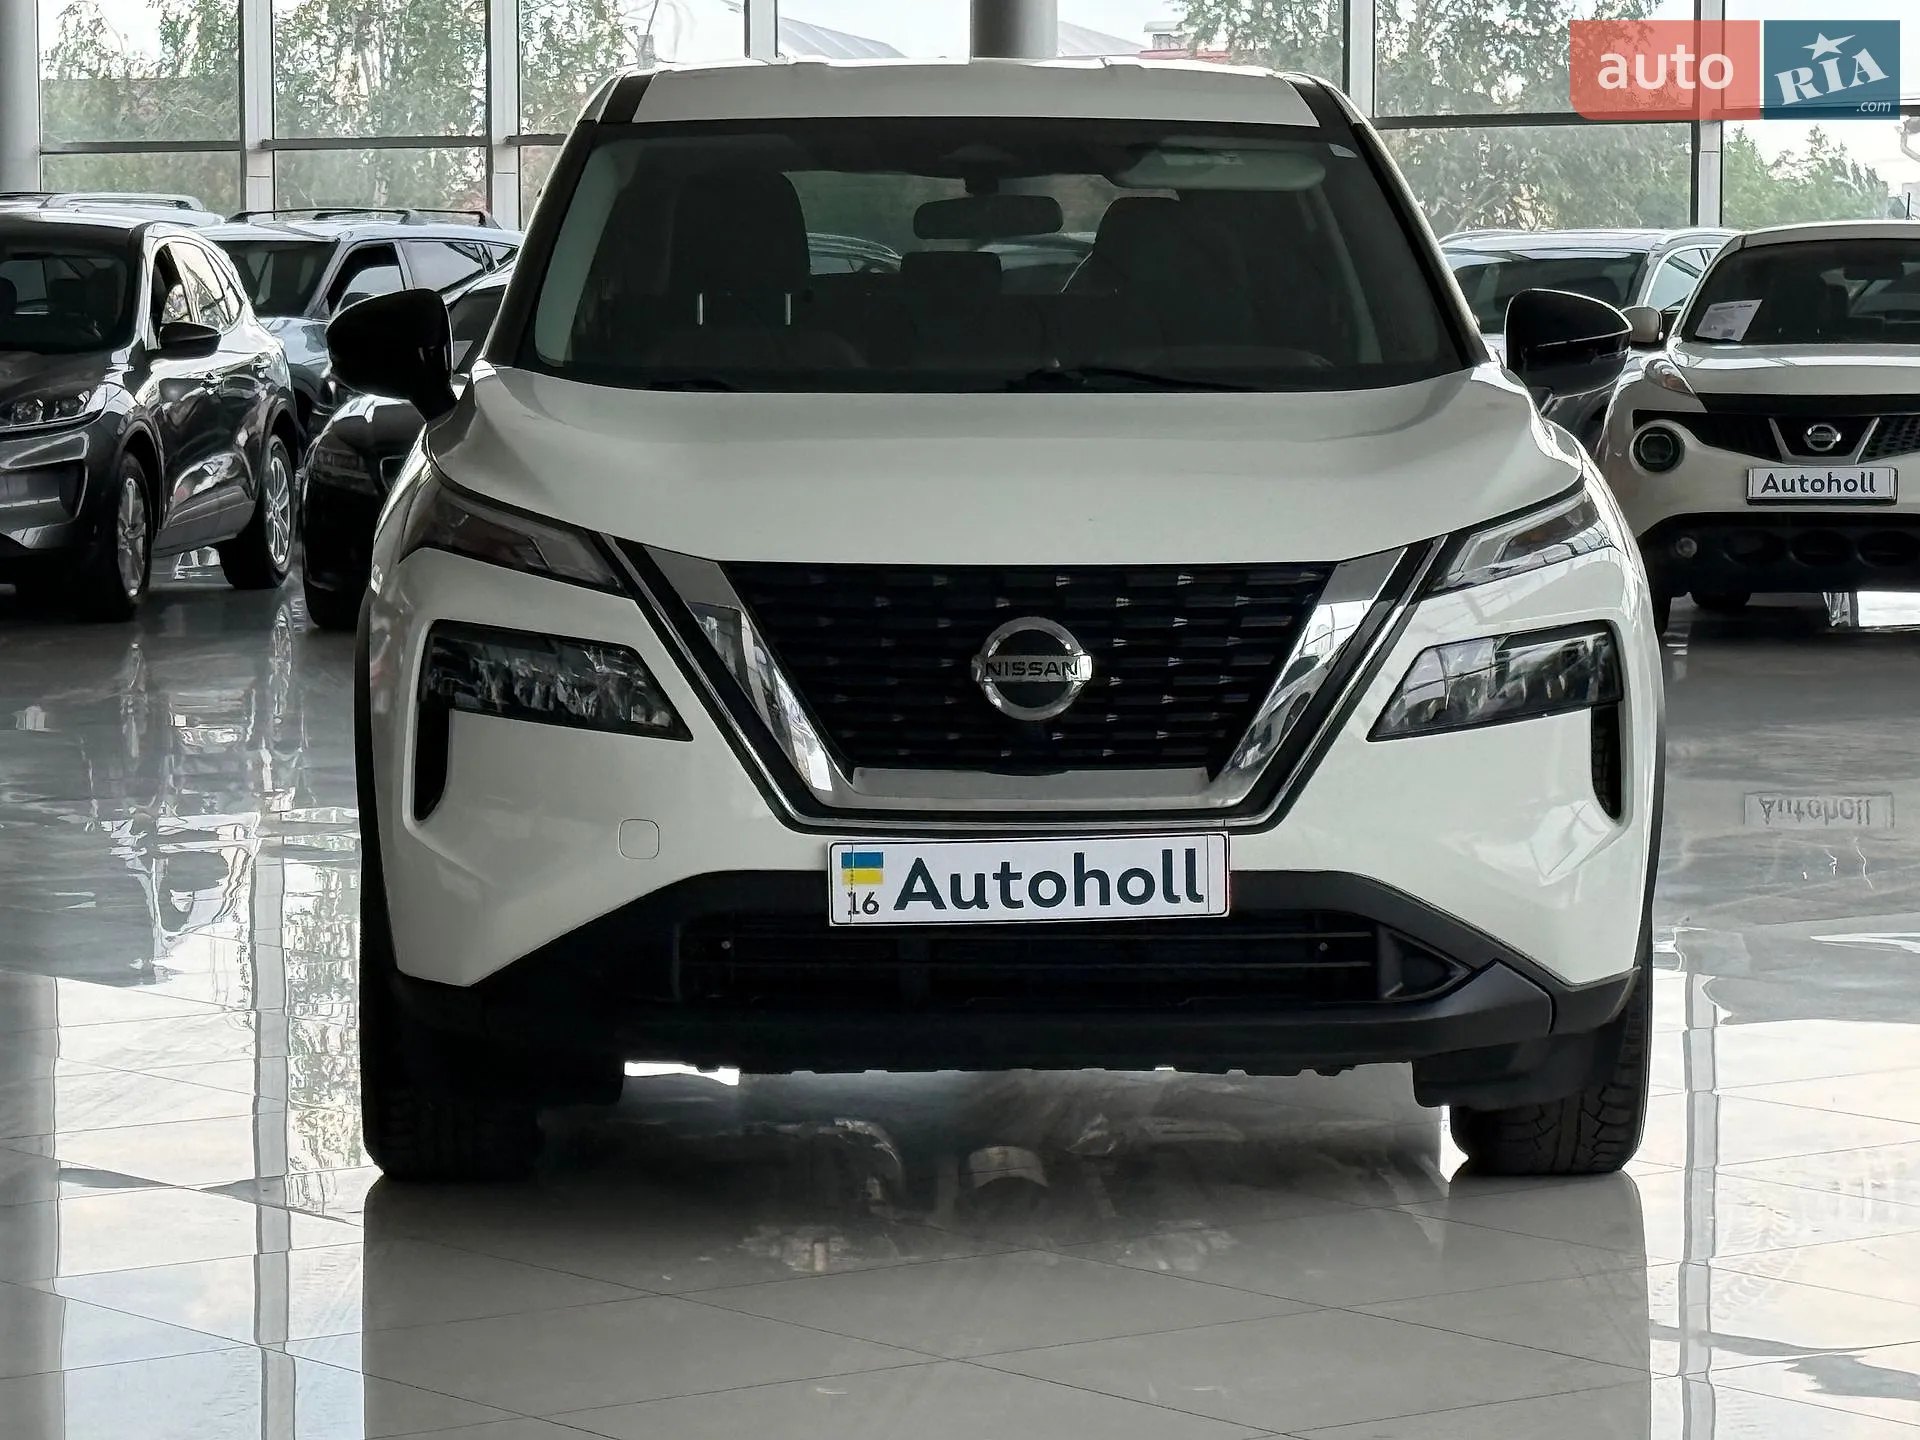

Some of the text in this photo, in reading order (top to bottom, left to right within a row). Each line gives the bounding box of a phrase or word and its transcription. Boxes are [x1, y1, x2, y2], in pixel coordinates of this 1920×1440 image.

[1761, 472, 1876, 494] Autoholl
[985, 661, 1078, 677] NISSAN
[847, 847, 1205, 916] 16 Autoholl
